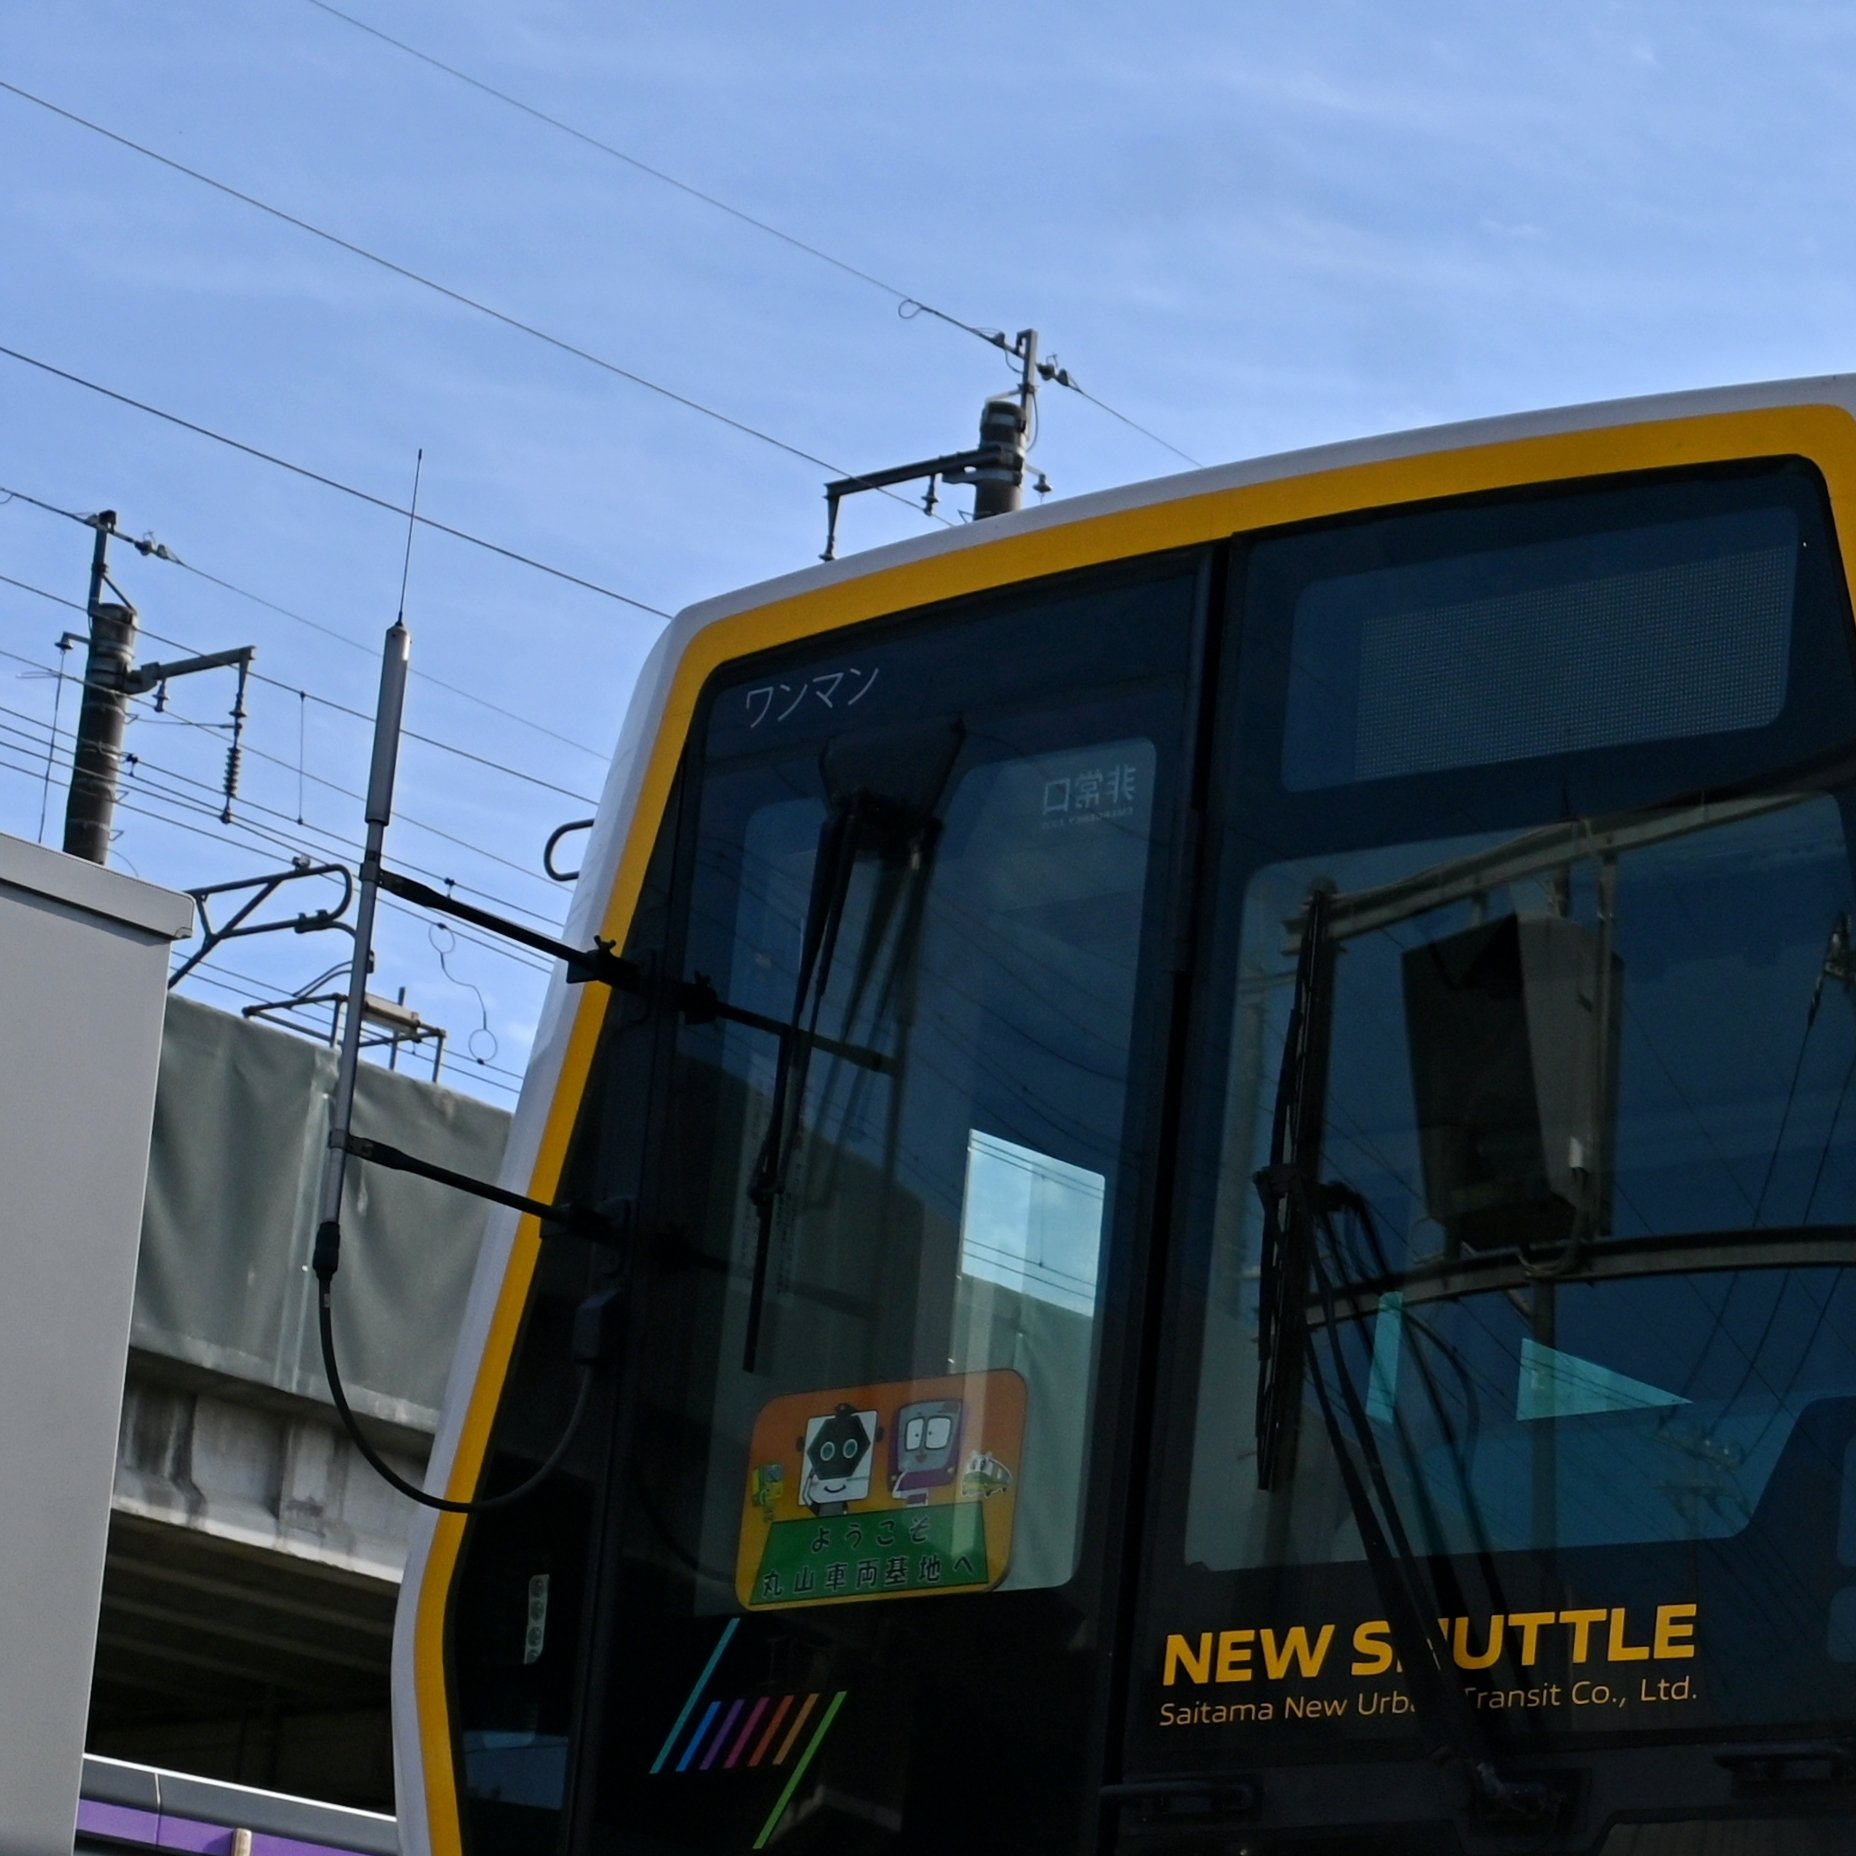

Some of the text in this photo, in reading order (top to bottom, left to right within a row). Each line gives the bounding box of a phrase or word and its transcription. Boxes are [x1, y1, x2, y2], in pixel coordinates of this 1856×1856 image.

[745, 667, 880, 729] ワンマン
[811, 1515, 931, 1553] ようこそ
[761, 1554, 976, 1598] 丸山車両基地へ
[1162, 1603, 1698, 1686] NEW SUTTLE
[1159, 1700, 1274, 1726] Saitama
[1284, 1696, 1348, 1719] New
[1358, 1690, 1416, 1716] Urb
[1571, 1680, 1626, 1708] Co.,
[1640, 1675, 1698, 1701] Ltd.
